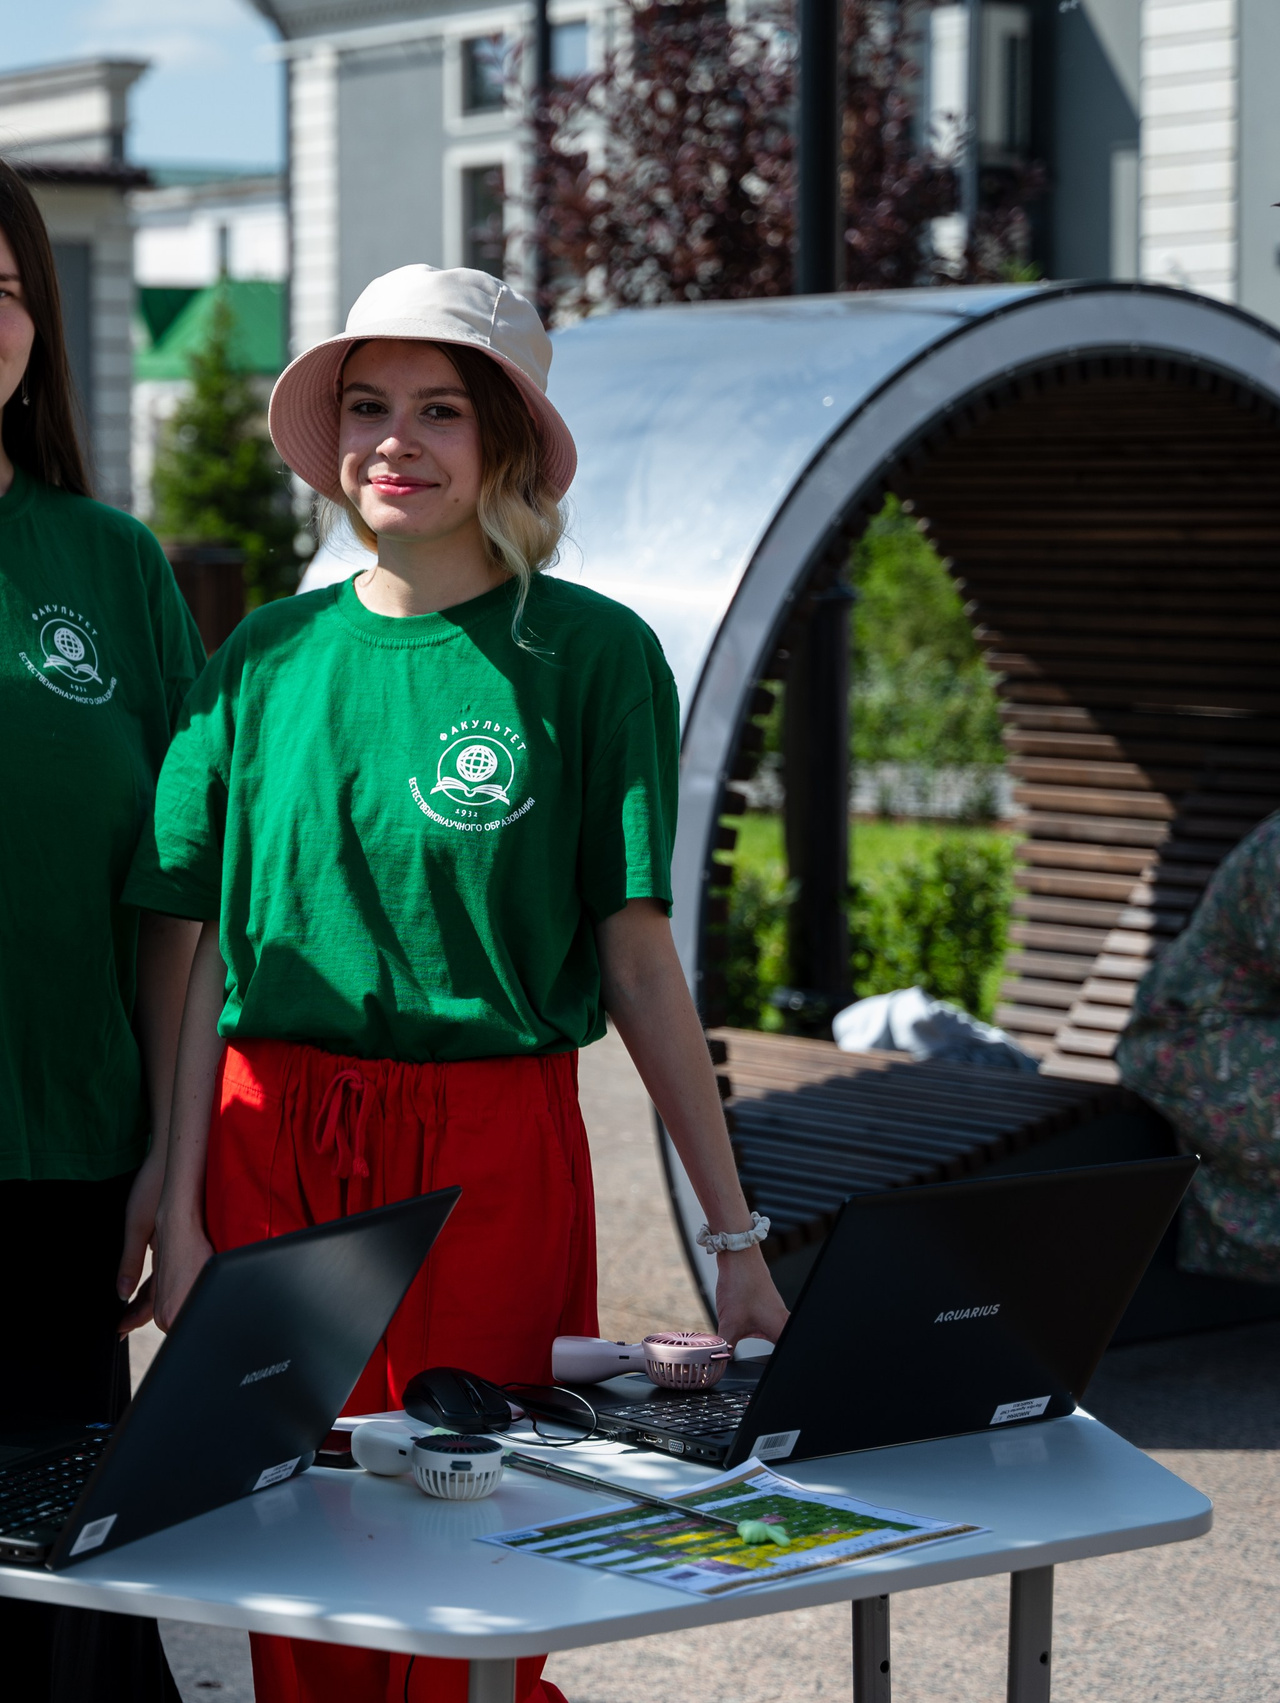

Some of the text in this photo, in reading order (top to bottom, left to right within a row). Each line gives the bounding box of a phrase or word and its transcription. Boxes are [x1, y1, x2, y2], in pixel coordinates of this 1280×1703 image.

[440, 720, 526, 750] ФАКУЛЬТЕТ
[408, 777, 536, 832] ЕСТЕСТВЕННОНАУЧНОГО ОБРАЗОВАНИЯ
[455, 808, 478, 818] 1932
[934, 1303, 1000, 1324] AQUARIUS
[239, 1359, 291, 1387] AQUARIUS
